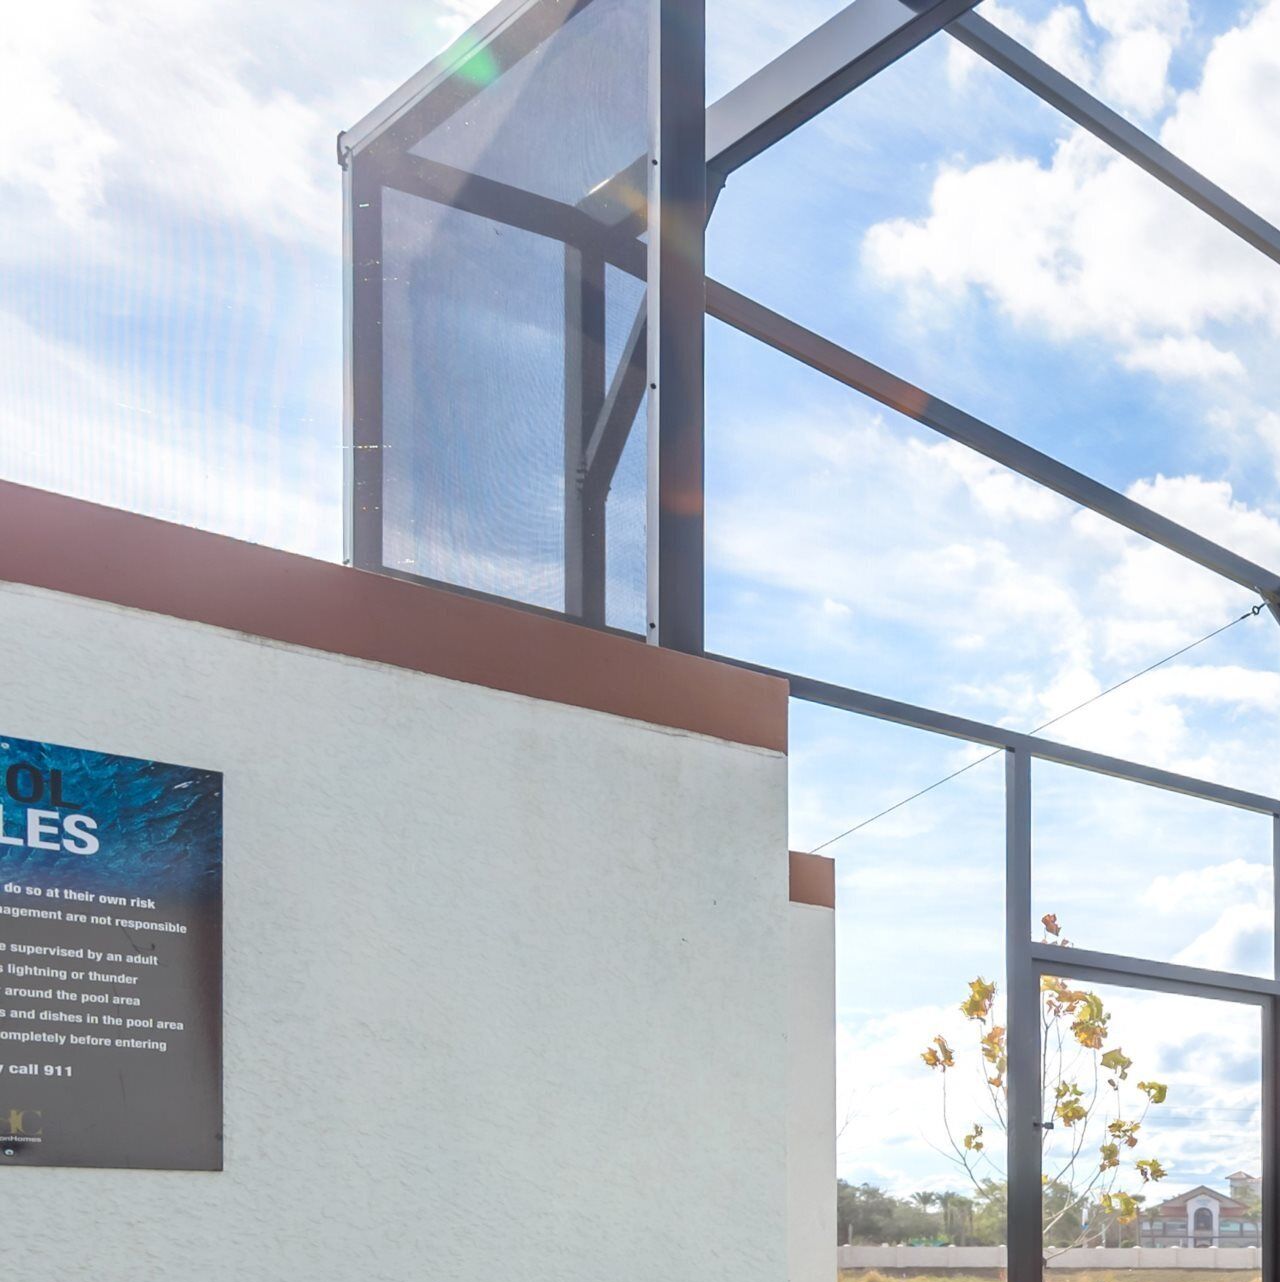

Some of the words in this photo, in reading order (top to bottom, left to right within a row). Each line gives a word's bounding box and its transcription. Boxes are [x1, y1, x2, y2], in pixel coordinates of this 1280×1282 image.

[0, 803, 100, 855] LES
[4, 882, 21, 894] do
[26, 886, 42, 896] so
[46, 888, 60, 898] at
[64, 889, 95, 902] their
[99, 895, 126, 906] own
[130, 897, 156, 910] risk
[0, 905, 62, 920] agement
[66, 913, 87, 923] are
[91, 915, 112, 926] not
[115, 917, 188, 934] responsible
[10, 944, 83, 959] supervised
[87, 949, 103, 962] by
[106, 952, 122, 963] an
[126, 954, 159, 966] adult
[8, 963, 67, 980] lightning
[71, 971, 85, 980] or
[88, 971, 138, 985] thunder
[5, 987, 53, 999] around
[56, 990, 78, 1001] the
[81, 993, 109, 1004] pool
[112, 995, 141, 1006] area
[10, 1009, 36, 1019] and
[39, 1010, 83, 1023] dishes
[86, 1013, 99, 1024] in
[102, 1014, 123, 1026] the
[126, 1018, 153, 1029] pool
[157, 1020, 184, 1031] area
[0, 1031, 66, 1046] ompletely
[70, 1034, 112, 1046] before
[115, 1038, 167, 1052] entering
[8, 1064, 39, 1075] call
[44, 1065, 72, 1077] 911
